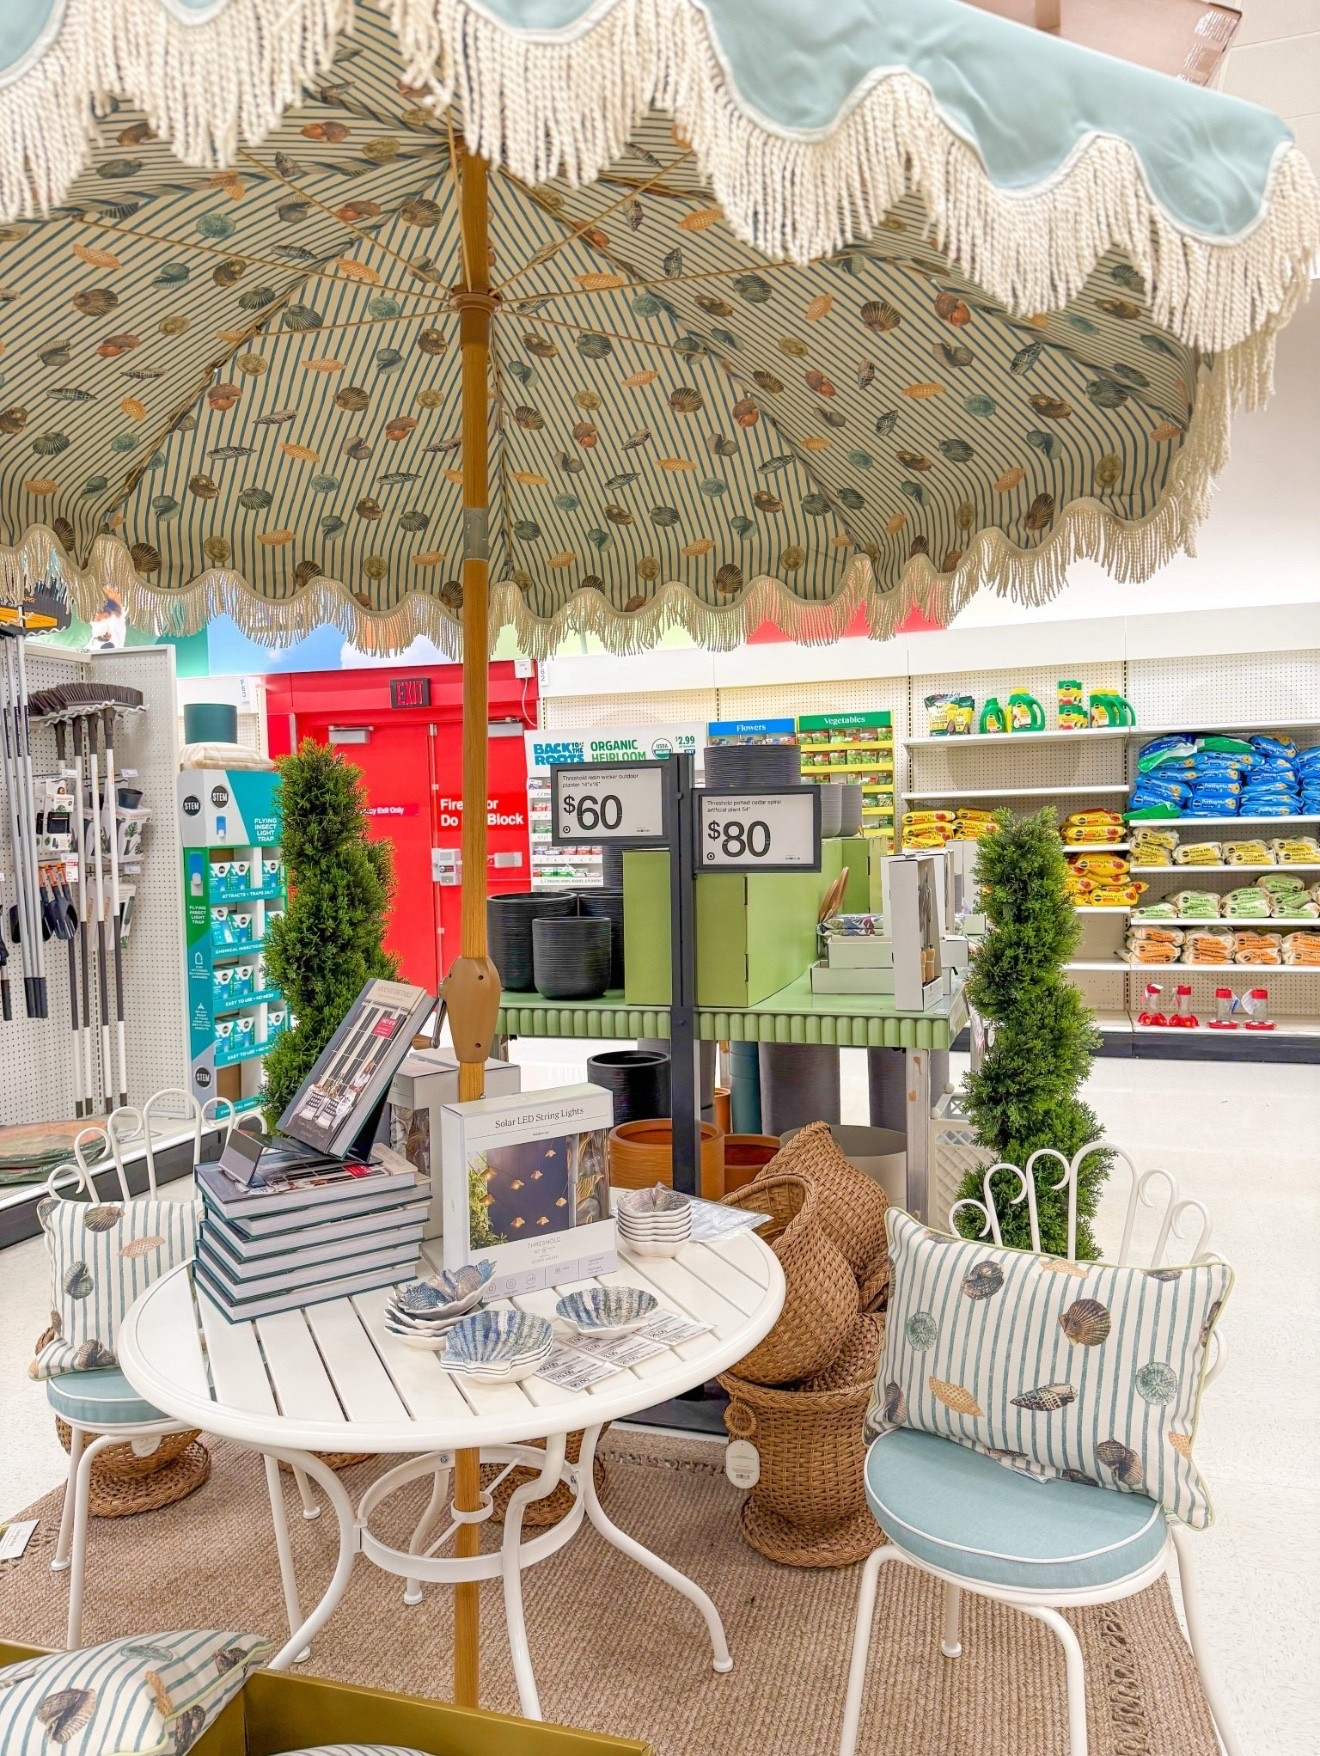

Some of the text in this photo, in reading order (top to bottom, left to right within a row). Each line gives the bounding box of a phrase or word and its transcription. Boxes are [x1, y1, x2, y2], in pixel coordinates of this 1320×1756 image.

[397, 681, 423, 705] EXIT
[823, 715, 866, 726] Vegetables
[736, 723, 767, 732] Flowers
[533, 742, 572, 755] BACK
[590, 739, 638, 752] ORGANIC
[534, 753, 585, 765] ROOTS
[591, 751, 647, 763] HEIRLOOM
[212, 793, 228, 802] STEM
[184, 801, 200, 811] STEM
[377, 806, 389, 815] Exit
[389, 806, 405, 816] Only
[440, 798, 464, 811] Fire
[563, 793, 623, 831] $60
[440, 813, 524, 827] Do Block
[707, 819, 771, 858] $80
[495, 1107, 585, 1129] Solar LED String Lights
[527, 1236, 562, 1249] THRESHOLD
